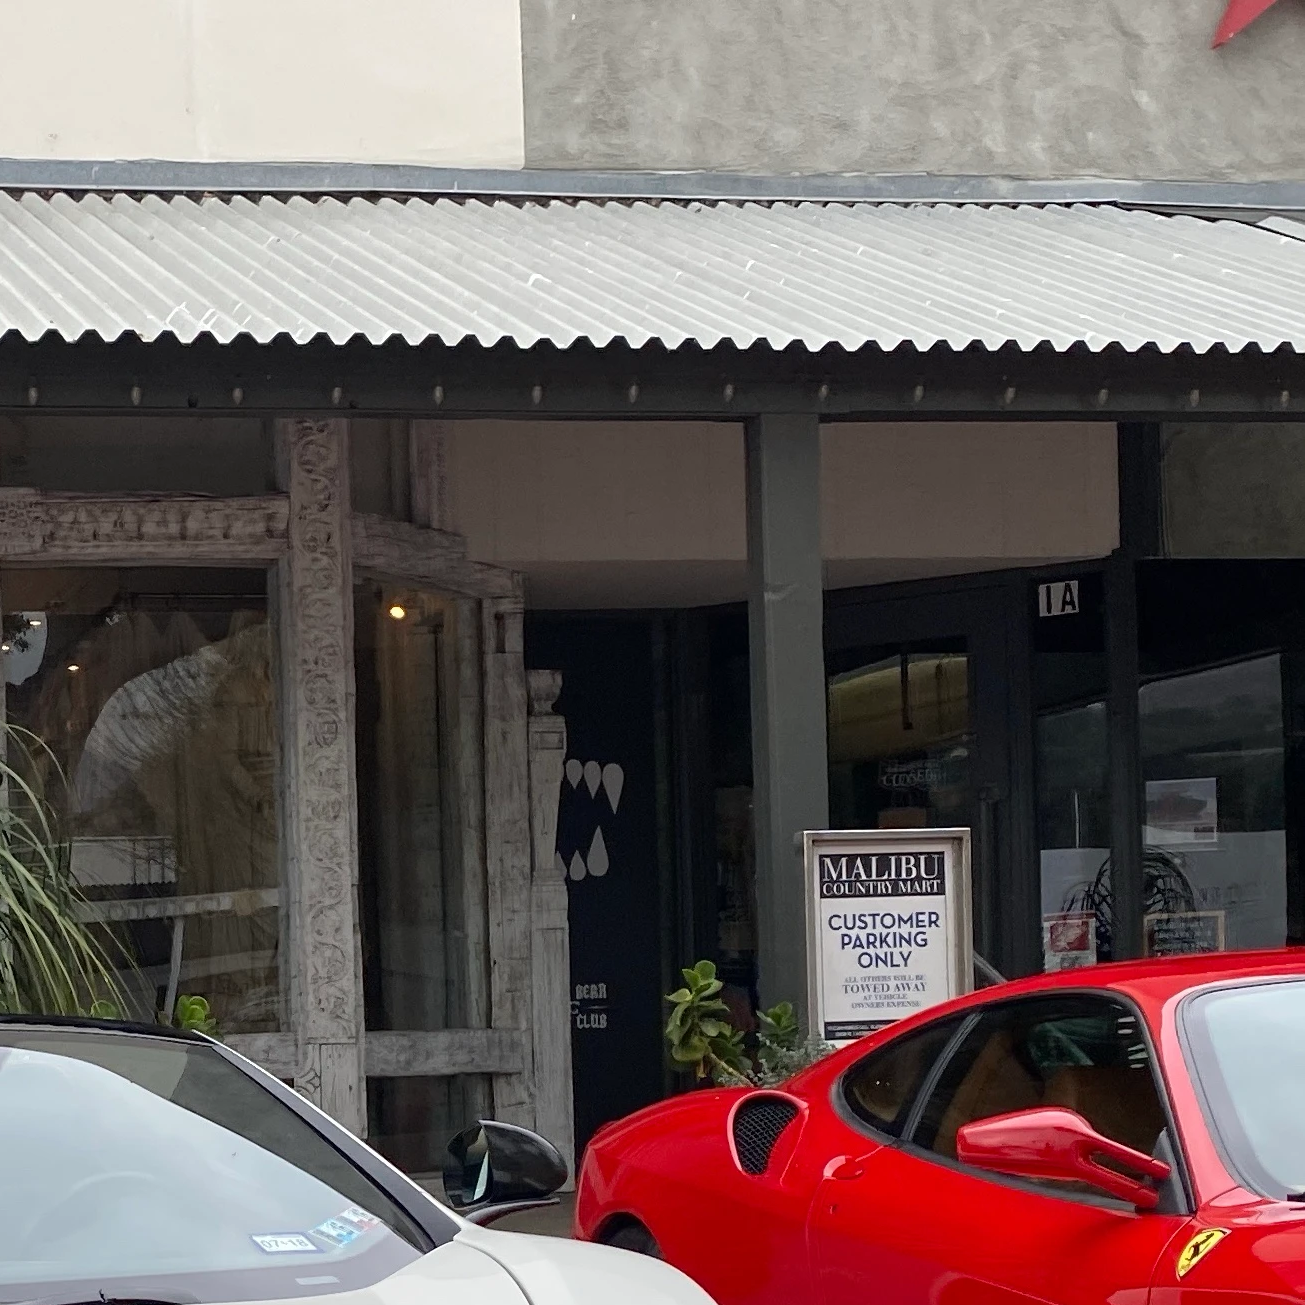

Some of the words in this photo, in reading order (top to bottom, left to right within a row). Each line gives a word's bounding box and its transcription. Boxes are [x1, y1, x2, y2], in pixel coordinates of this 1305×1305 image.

[822, 854, 942, 881] MALIBU
[822, 881, 894, 896] COUNTRY
[898, 880, 941, 893] MART
[828, 911, 940, 931] CUSTOMER
[841, 931, 928, 950] PARKING
[857, 951, 913, 969] ONLY
[842, 983, 891, 994] TOWED
[894, 981, 927, 993] AWAY
[844, 976, 858, 984] ALL
[860, 975, 892, 983] OTHERS
[874, 993, 908, 1001] VEHICLE
[886, 1000, 922, 1009] EXPENSE
[576, 1013, 608, 1030] CLUB
